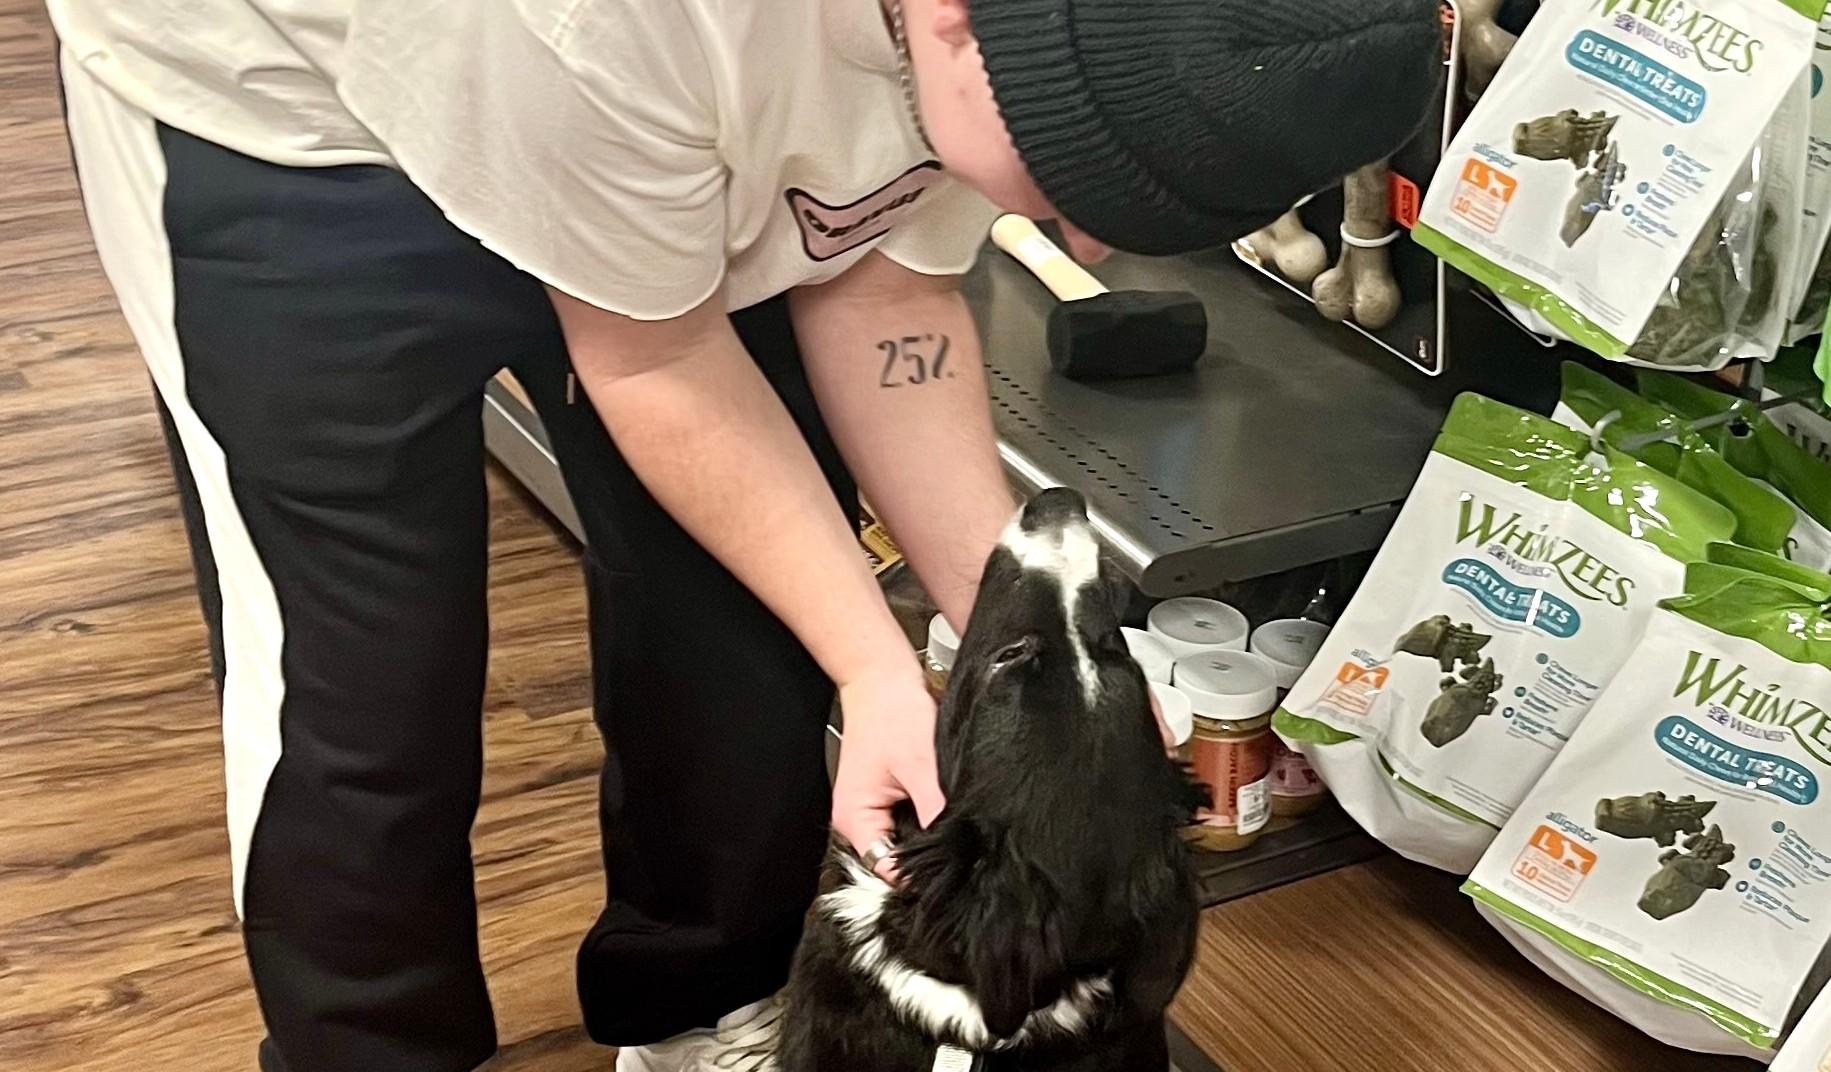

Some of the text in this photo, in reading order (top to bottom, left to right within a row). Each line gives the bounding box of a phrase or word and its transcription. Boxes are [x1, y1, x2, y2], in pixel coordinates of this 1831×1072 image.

[1578, 37, 1643, 81] DENTAL
[1643, 67, 1702, 108] TREATS
[1454, 563, 1517, 604] DENTAL
[1516, 592, 1571, 624] TRATS
[1669, 723, 1740, 769] DENTAL
[1744, 757, 1810, 789] TREATS
[1538, 832, 1552, 851] L
[1545, 811, 1598, 843] alligator
[1517, 861, 1539, 880] 10
